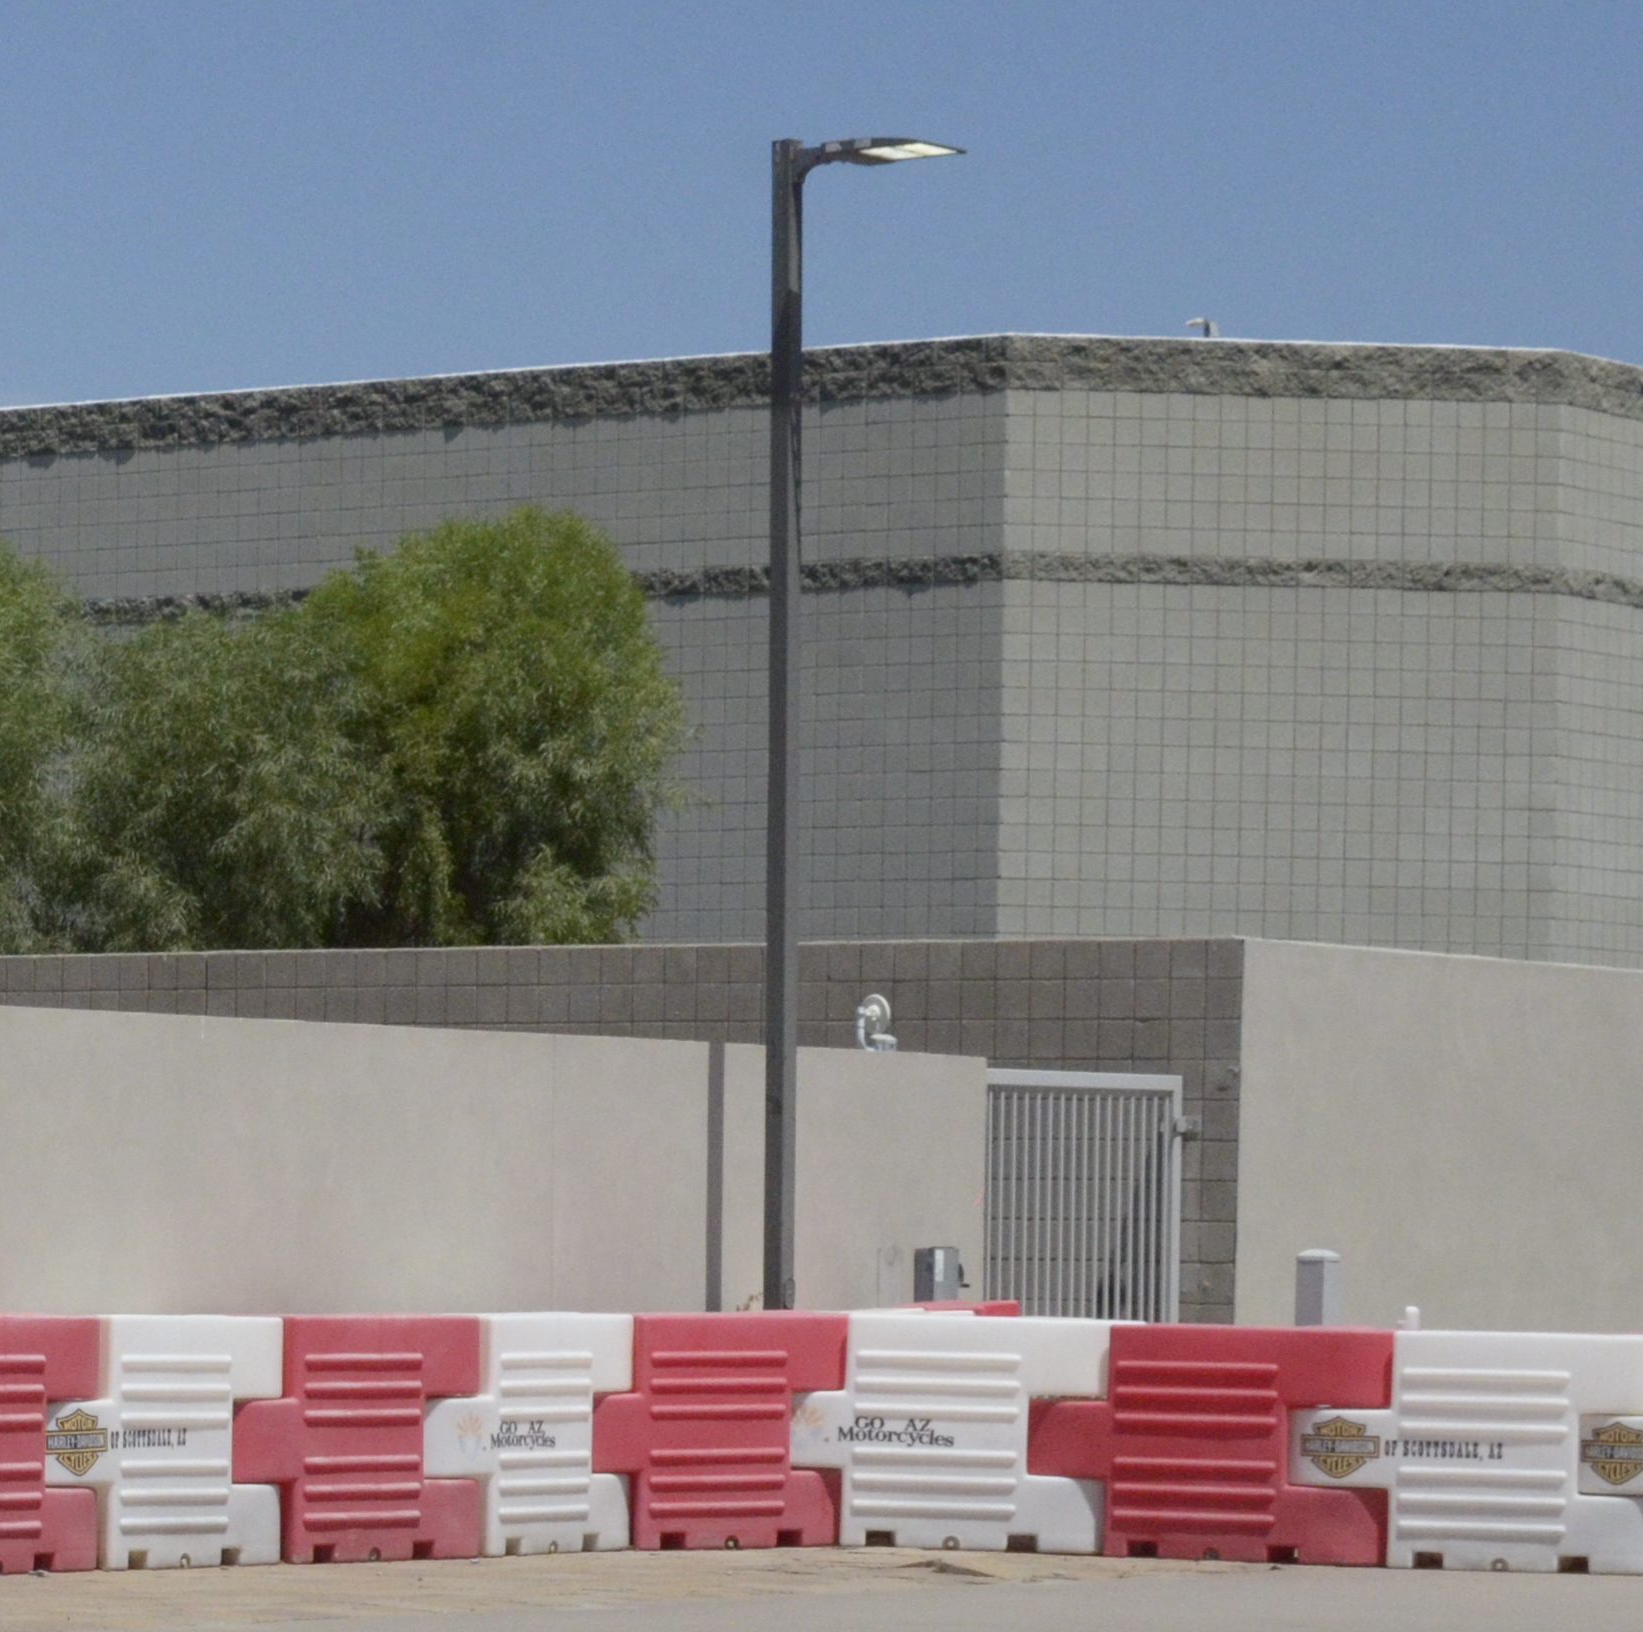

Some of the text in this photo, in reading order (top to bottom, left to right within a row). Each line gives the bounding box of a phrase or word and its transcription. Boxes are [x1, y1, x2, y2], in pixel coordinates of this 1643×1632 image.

[499, 1420, 545, 1435] GO AZ
[855, 1416, 932, 1432] GO AZ
[490, 1431, 556, 1450] Motorcycles
[837, 1426, 955, 1447] Motorcycles
